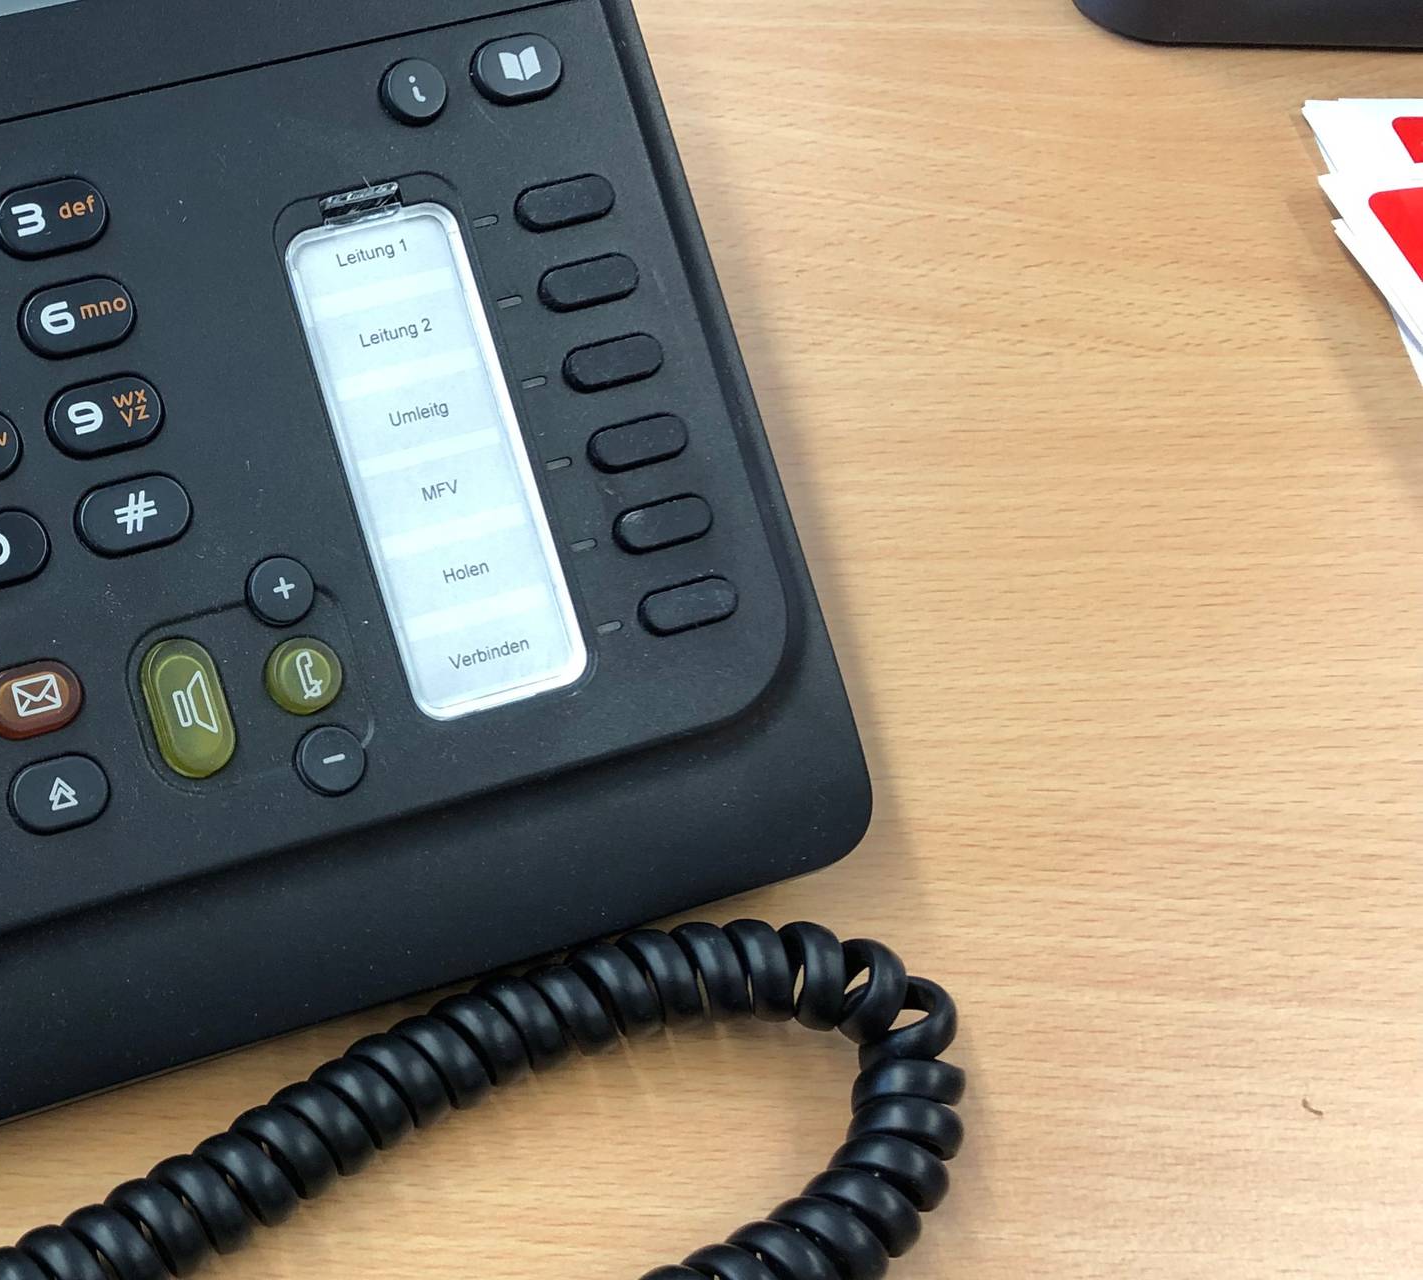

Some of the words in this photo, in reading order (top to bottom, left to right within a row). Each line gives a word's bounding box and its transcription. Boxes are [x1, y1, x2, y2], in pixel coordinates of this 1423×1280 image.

[10, 202, 47, 238] 3
[58, 195, 97, 220] def
[335, 242, 396, 268] Leitung
[398, 238, 408, 253] 1
[40, 300, 76, 336] 6
[79, 296, 127, 321] mno
[359, 323, 419, 348] Leitung
[420, 317, 433, 333] 2
[67, 400, 104, 436] 9
[112, 388, 147, 409] wx
[119, 404, 150, 428] yz
[388, 401, 450, 427] Umleitg
[420, 479, 458, 502] MFV
[442, 561, 490, 584] Holen
[448, 637, 530, 670] Verbinden
